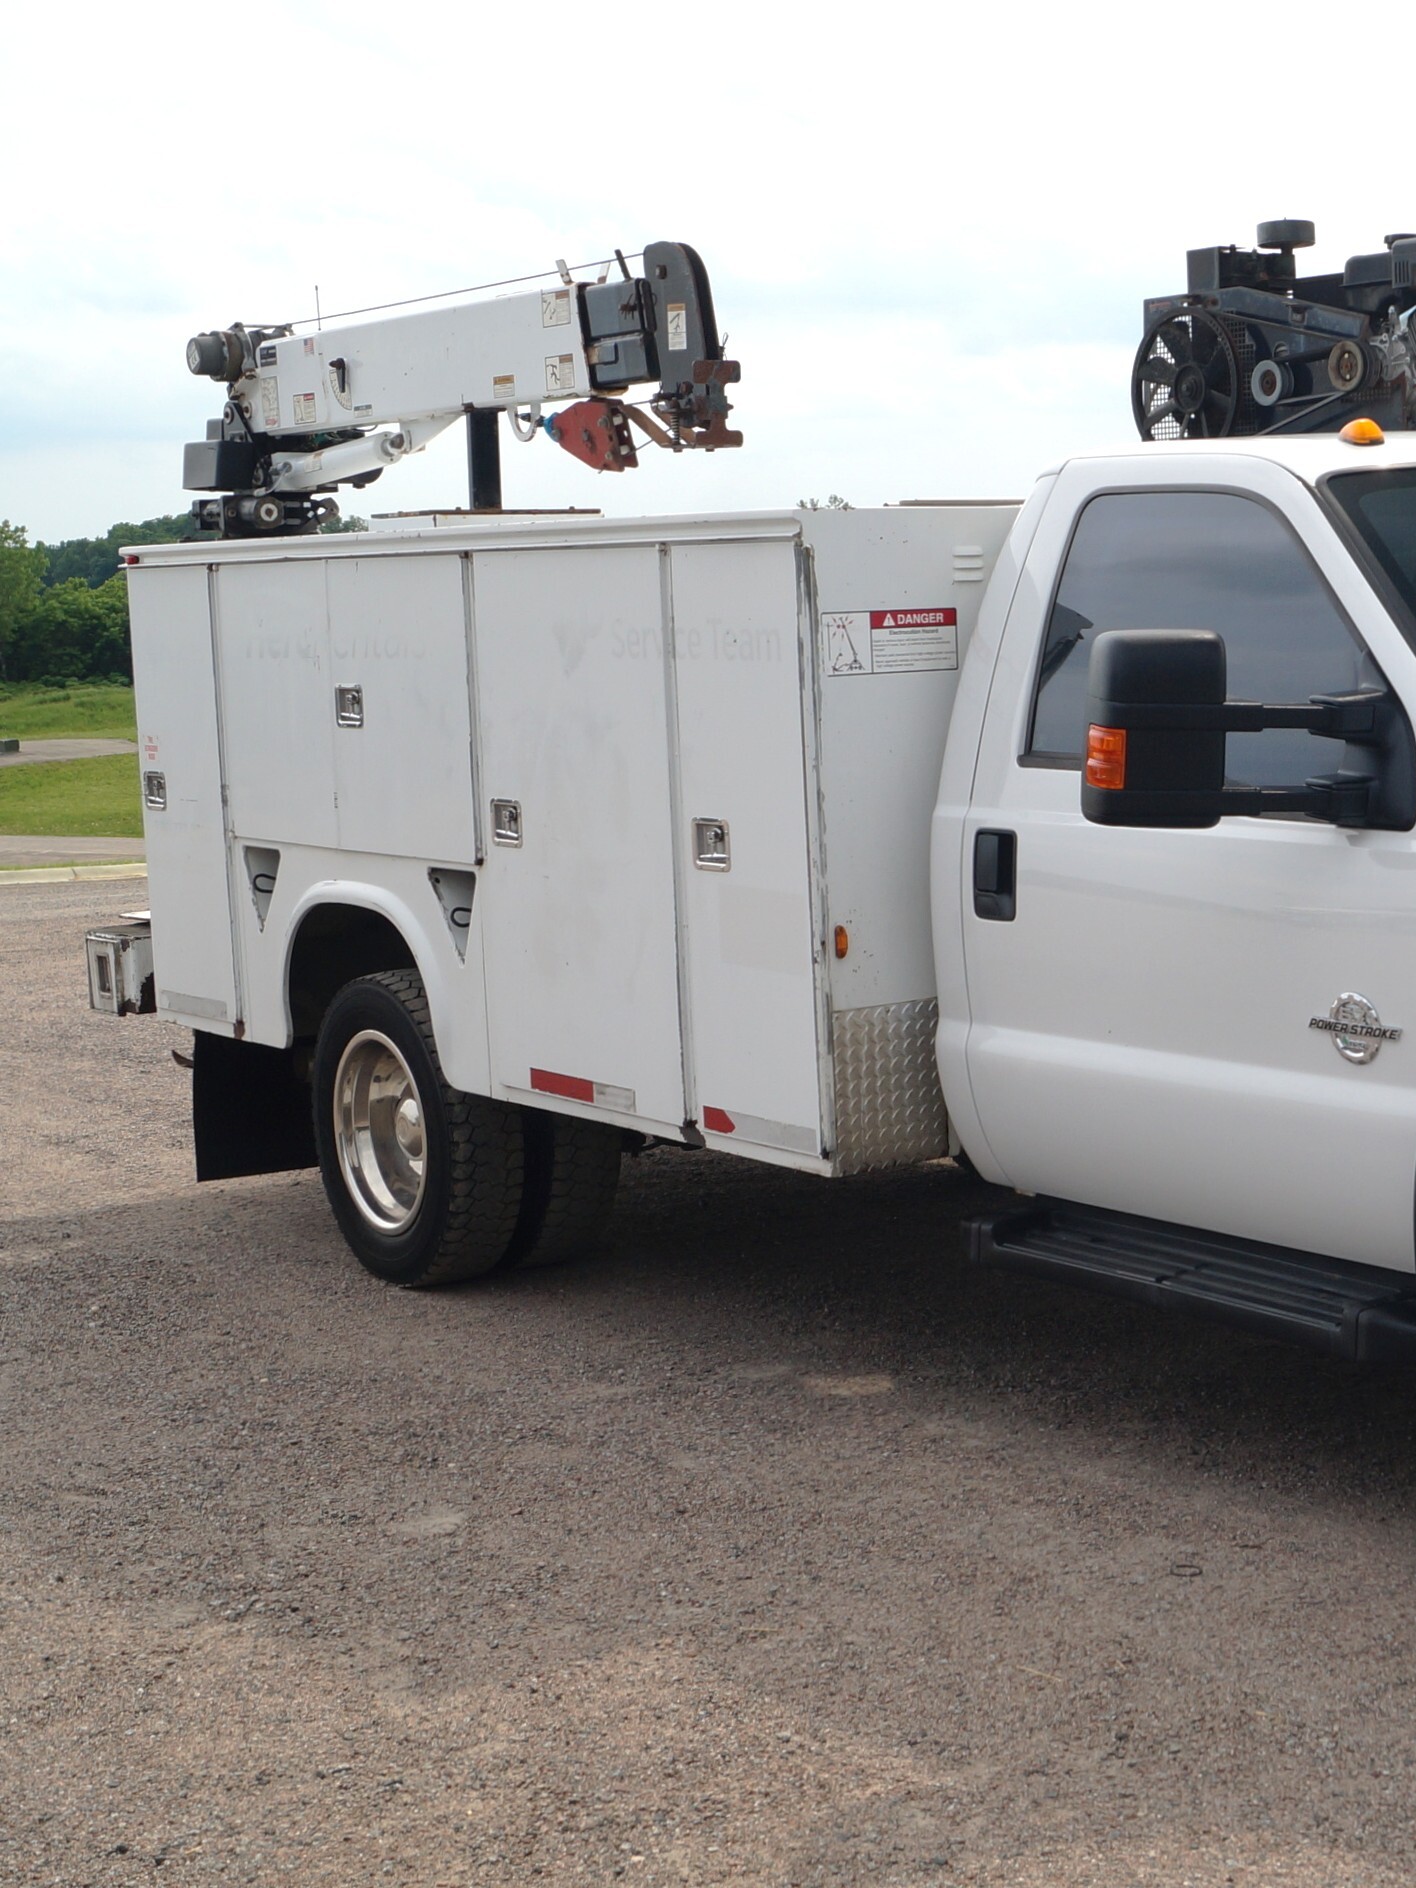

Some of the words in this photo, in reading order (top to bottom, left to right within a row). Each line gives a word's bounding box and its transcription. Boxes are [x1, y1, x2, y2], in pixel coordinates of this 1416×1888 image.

[897, 612, 944, 626] DANGER
[610, 616, 702, 660] Servce
[706, 617, 783, 662] Team
[1308, 1018, 1349, 1034] POWER
[1348, 1023, 1399, 1041] STROKE
